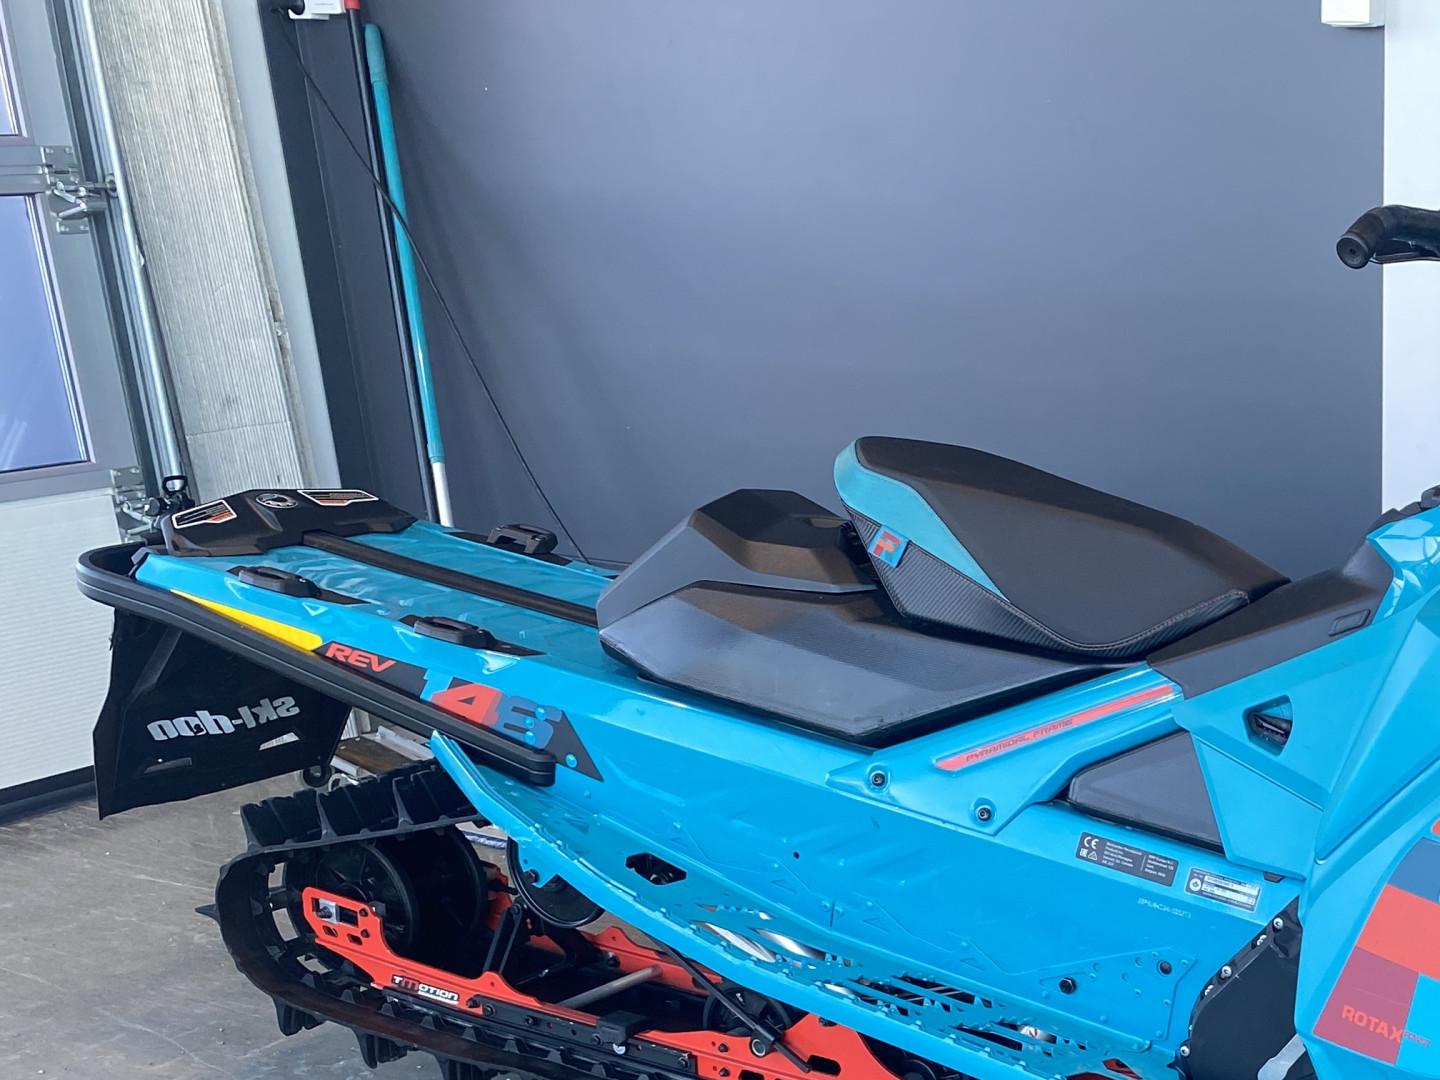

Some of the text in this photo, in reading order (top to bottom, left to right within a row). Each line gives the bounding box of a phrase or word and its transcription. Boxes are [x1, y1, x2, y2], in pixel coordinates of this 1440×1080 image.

[324, 641, 396, 673] REV
[965, 718, 1074, 763] PYRAMIDAL FRAME
[1341, 1004, 1404, 1044] ROTAX
